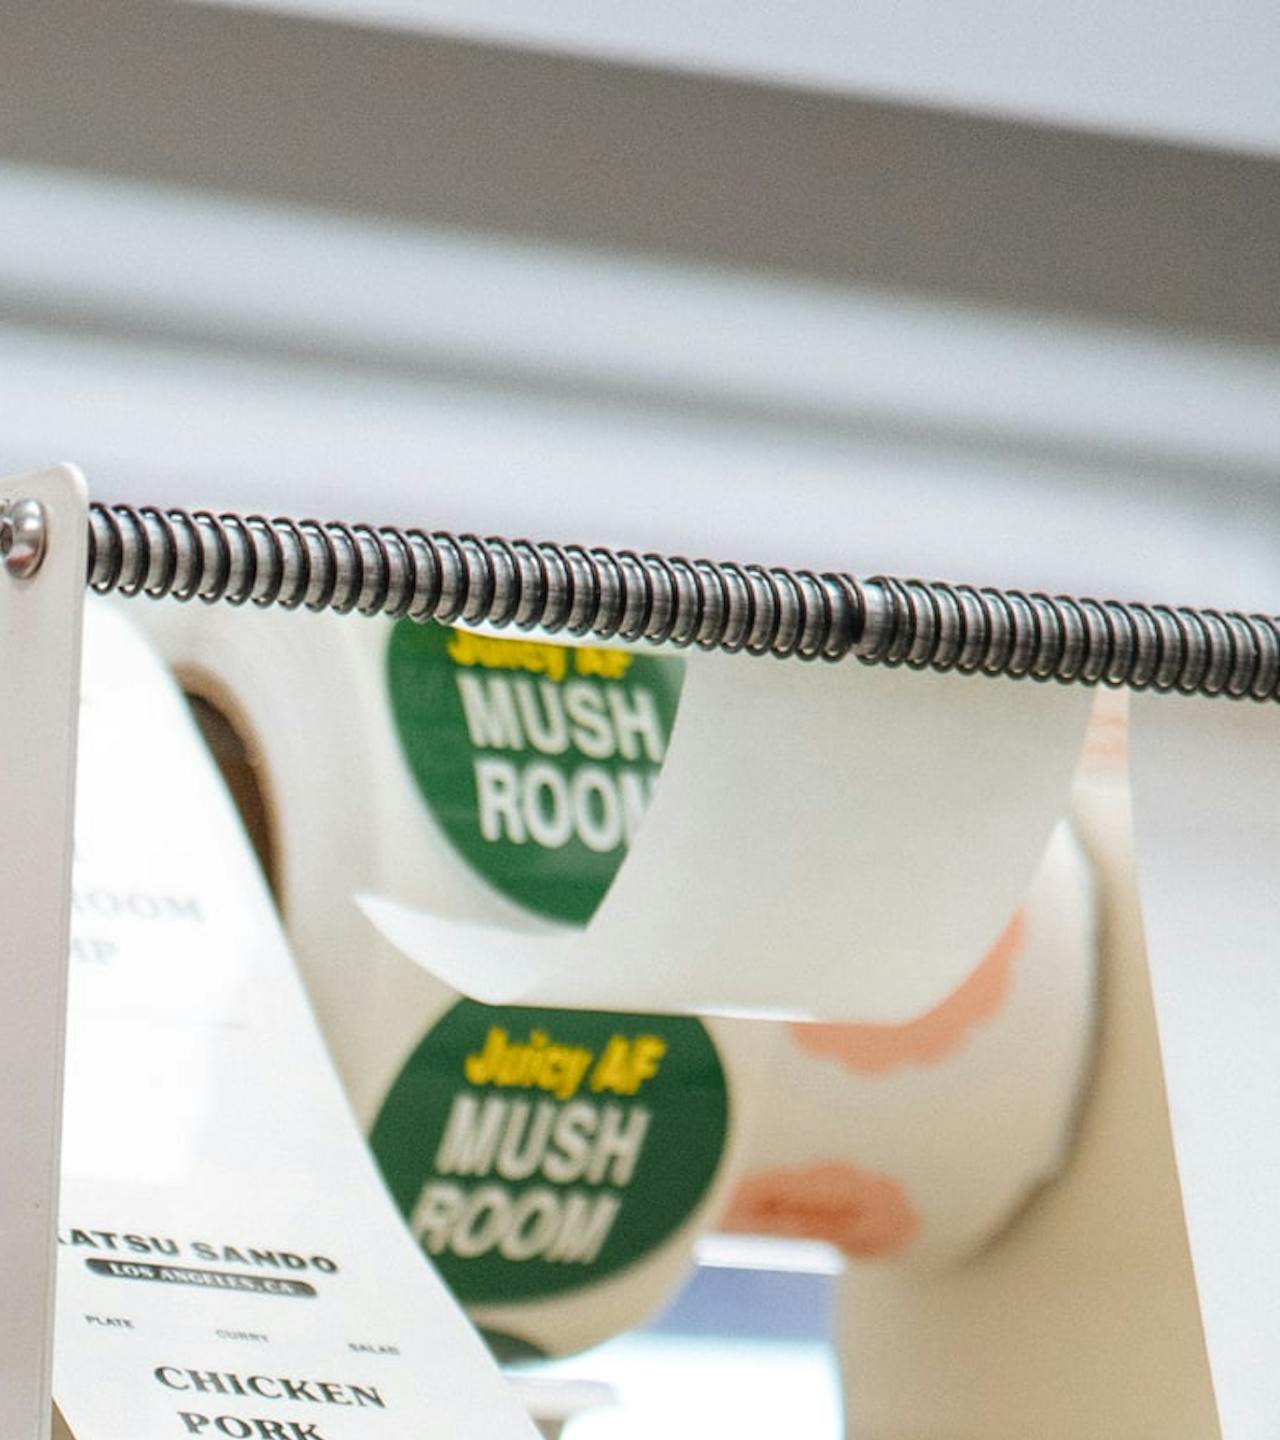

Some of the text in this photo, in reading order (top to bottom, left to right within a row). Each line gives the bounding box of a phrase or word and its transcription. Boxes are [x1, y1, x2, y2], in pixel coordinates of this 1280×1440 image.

[456, 671, 664, 764] MUSH
[465, 1029, 668, 1099] Juicy AF
[435, 1096, 651, 1187] MUSH
[58, 1228, 338, 1273] ATSU SANDO
[412, 1185, 619, 1264] ROOM
[109, 1263, 152, 1278] LOS
[85, 1315, 400, 1356] PLATE CURRY SALAD
[154, 1365, 385, 1409] CHICKEN
